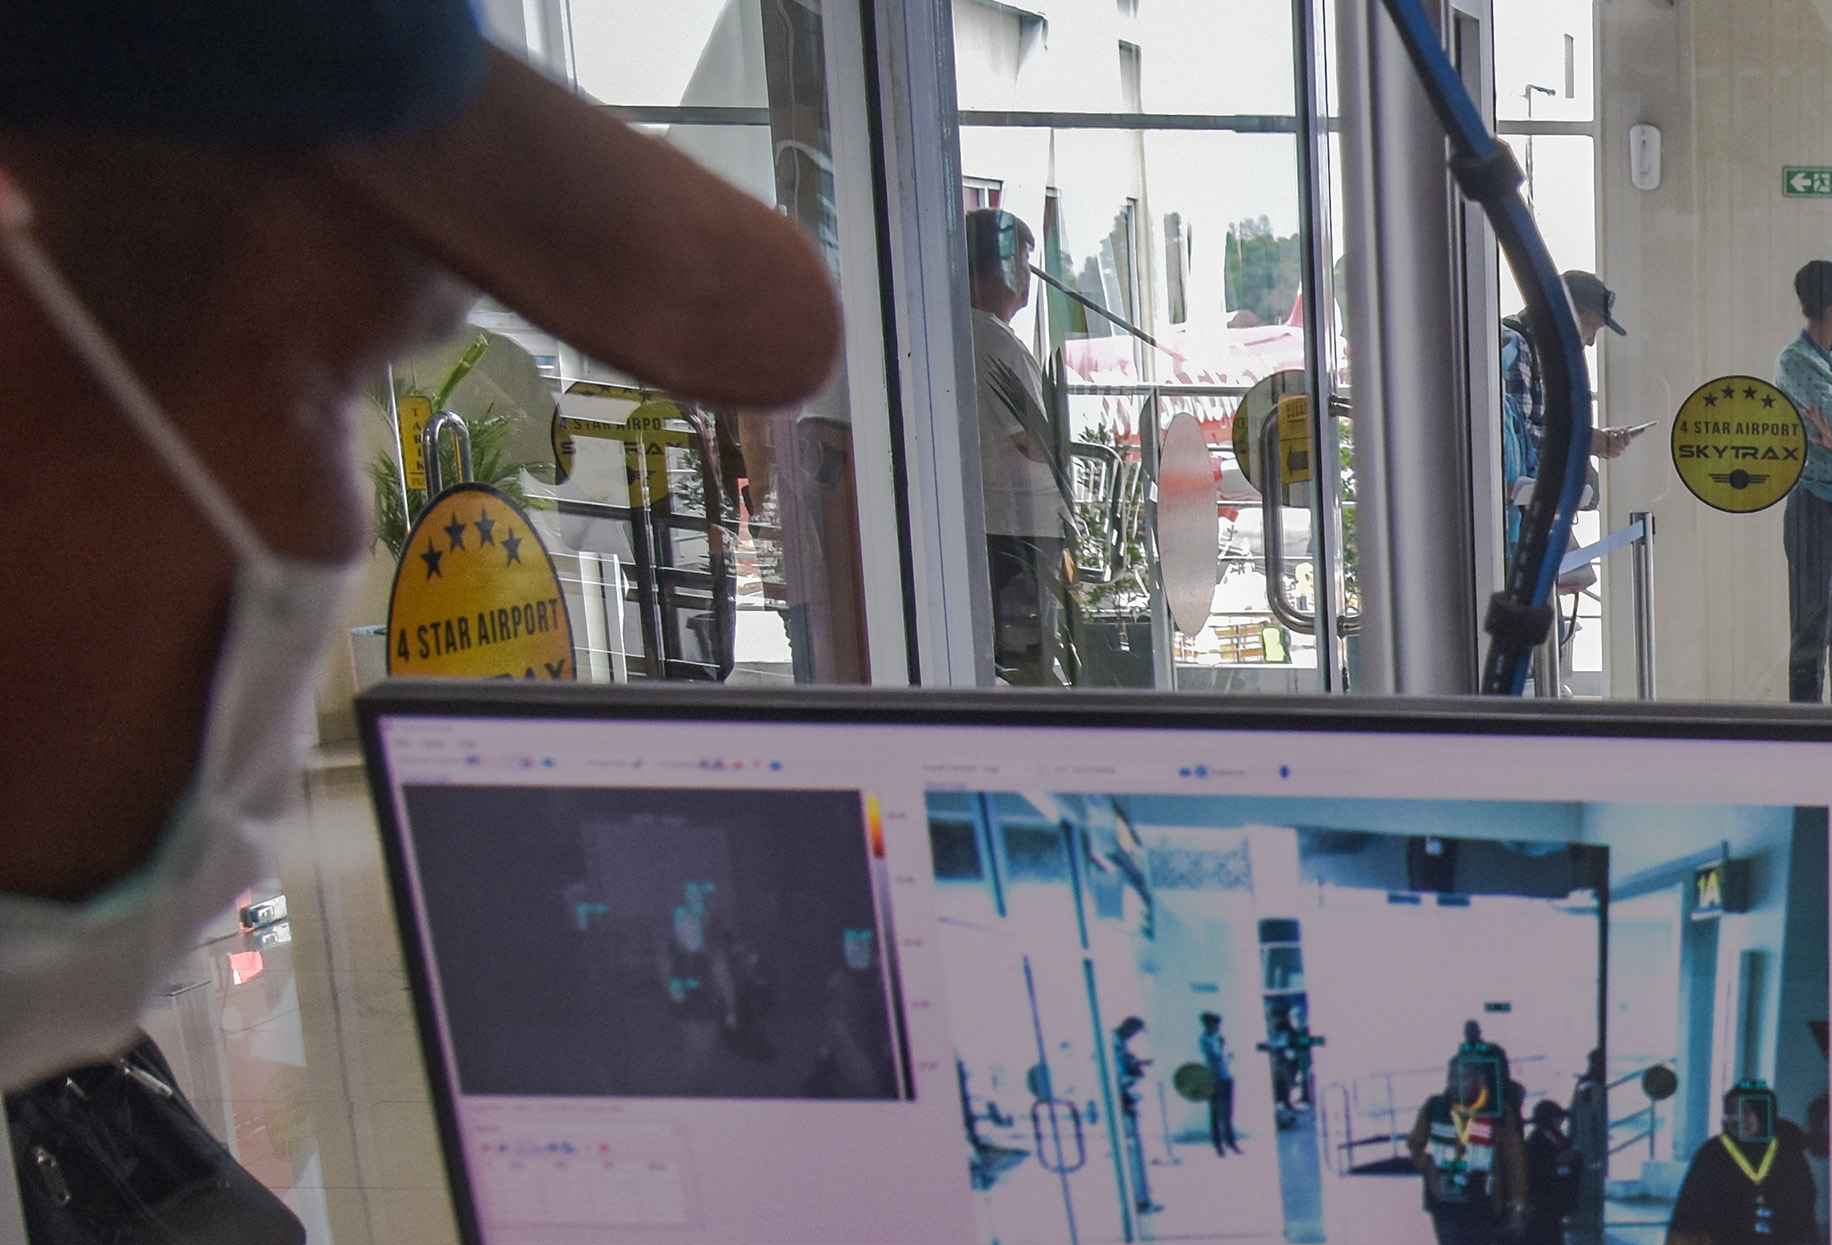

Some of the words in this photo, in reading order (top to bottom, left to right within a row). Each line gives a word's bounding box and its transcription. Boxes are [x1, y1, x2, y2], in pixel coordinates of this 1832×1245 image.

[1680, 421, 1688, 433] 4
[1694, 421, 1731, 434] STAR
[1735, 422, 1799, 436] AIRPORT
[1678, 445, 1800, 461] SKYTRAX
[397, 629, 410, 662] 4
[417, 616, 471, 660] STAR
[477, 598, 559, 646] AIRPORT
